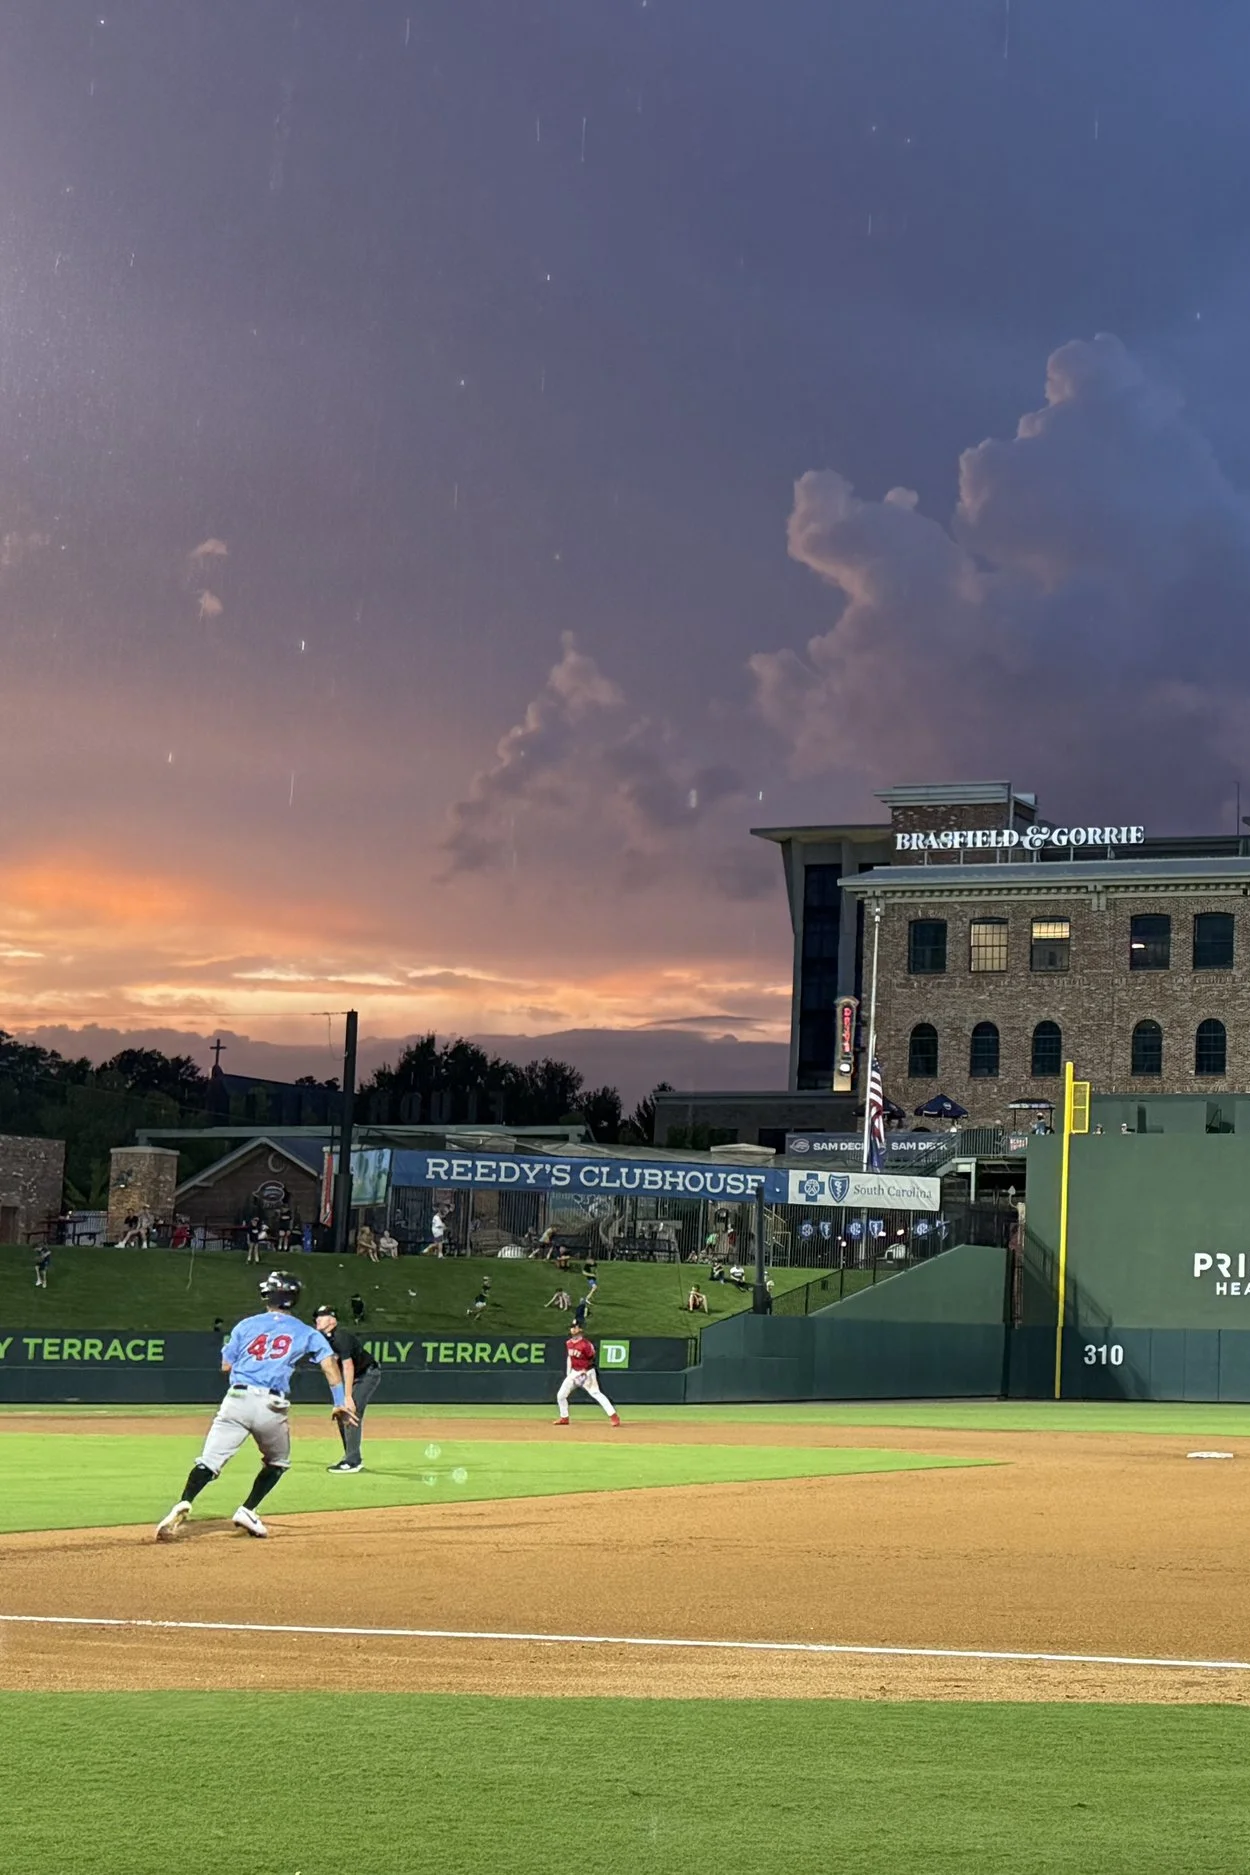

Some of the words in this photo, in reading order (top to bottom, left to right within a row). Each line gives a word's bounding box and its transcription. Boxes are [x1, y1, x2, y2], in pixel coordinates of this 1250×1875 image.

[895, 829, 1019, 851] BRASFIELD
[1022, 825, 1050, 851] &
[1051, 826, 1145, 847] GORRIE
[813, 1142, 838, 1151] SAM
[891, 1142, 917, 1151] SAM
[426, 1158, 571, 1187] REEDY'S
[579, 1165, 766, 1195] CLUBHOUSE
[853, 1184, 885, 1197] South
[888, 1186, 932, 1199] Carolina
[22, 1338, 165, 1361] TERRACE
[247, 1333, 292, 1361] 49
[363, 1341, 414, 1363] ILY
[422, 1342, 546, 1363] TERRACE
[602, 1345, 626, 1363] TD
[1083, 1344, 1123, 1366] 310
